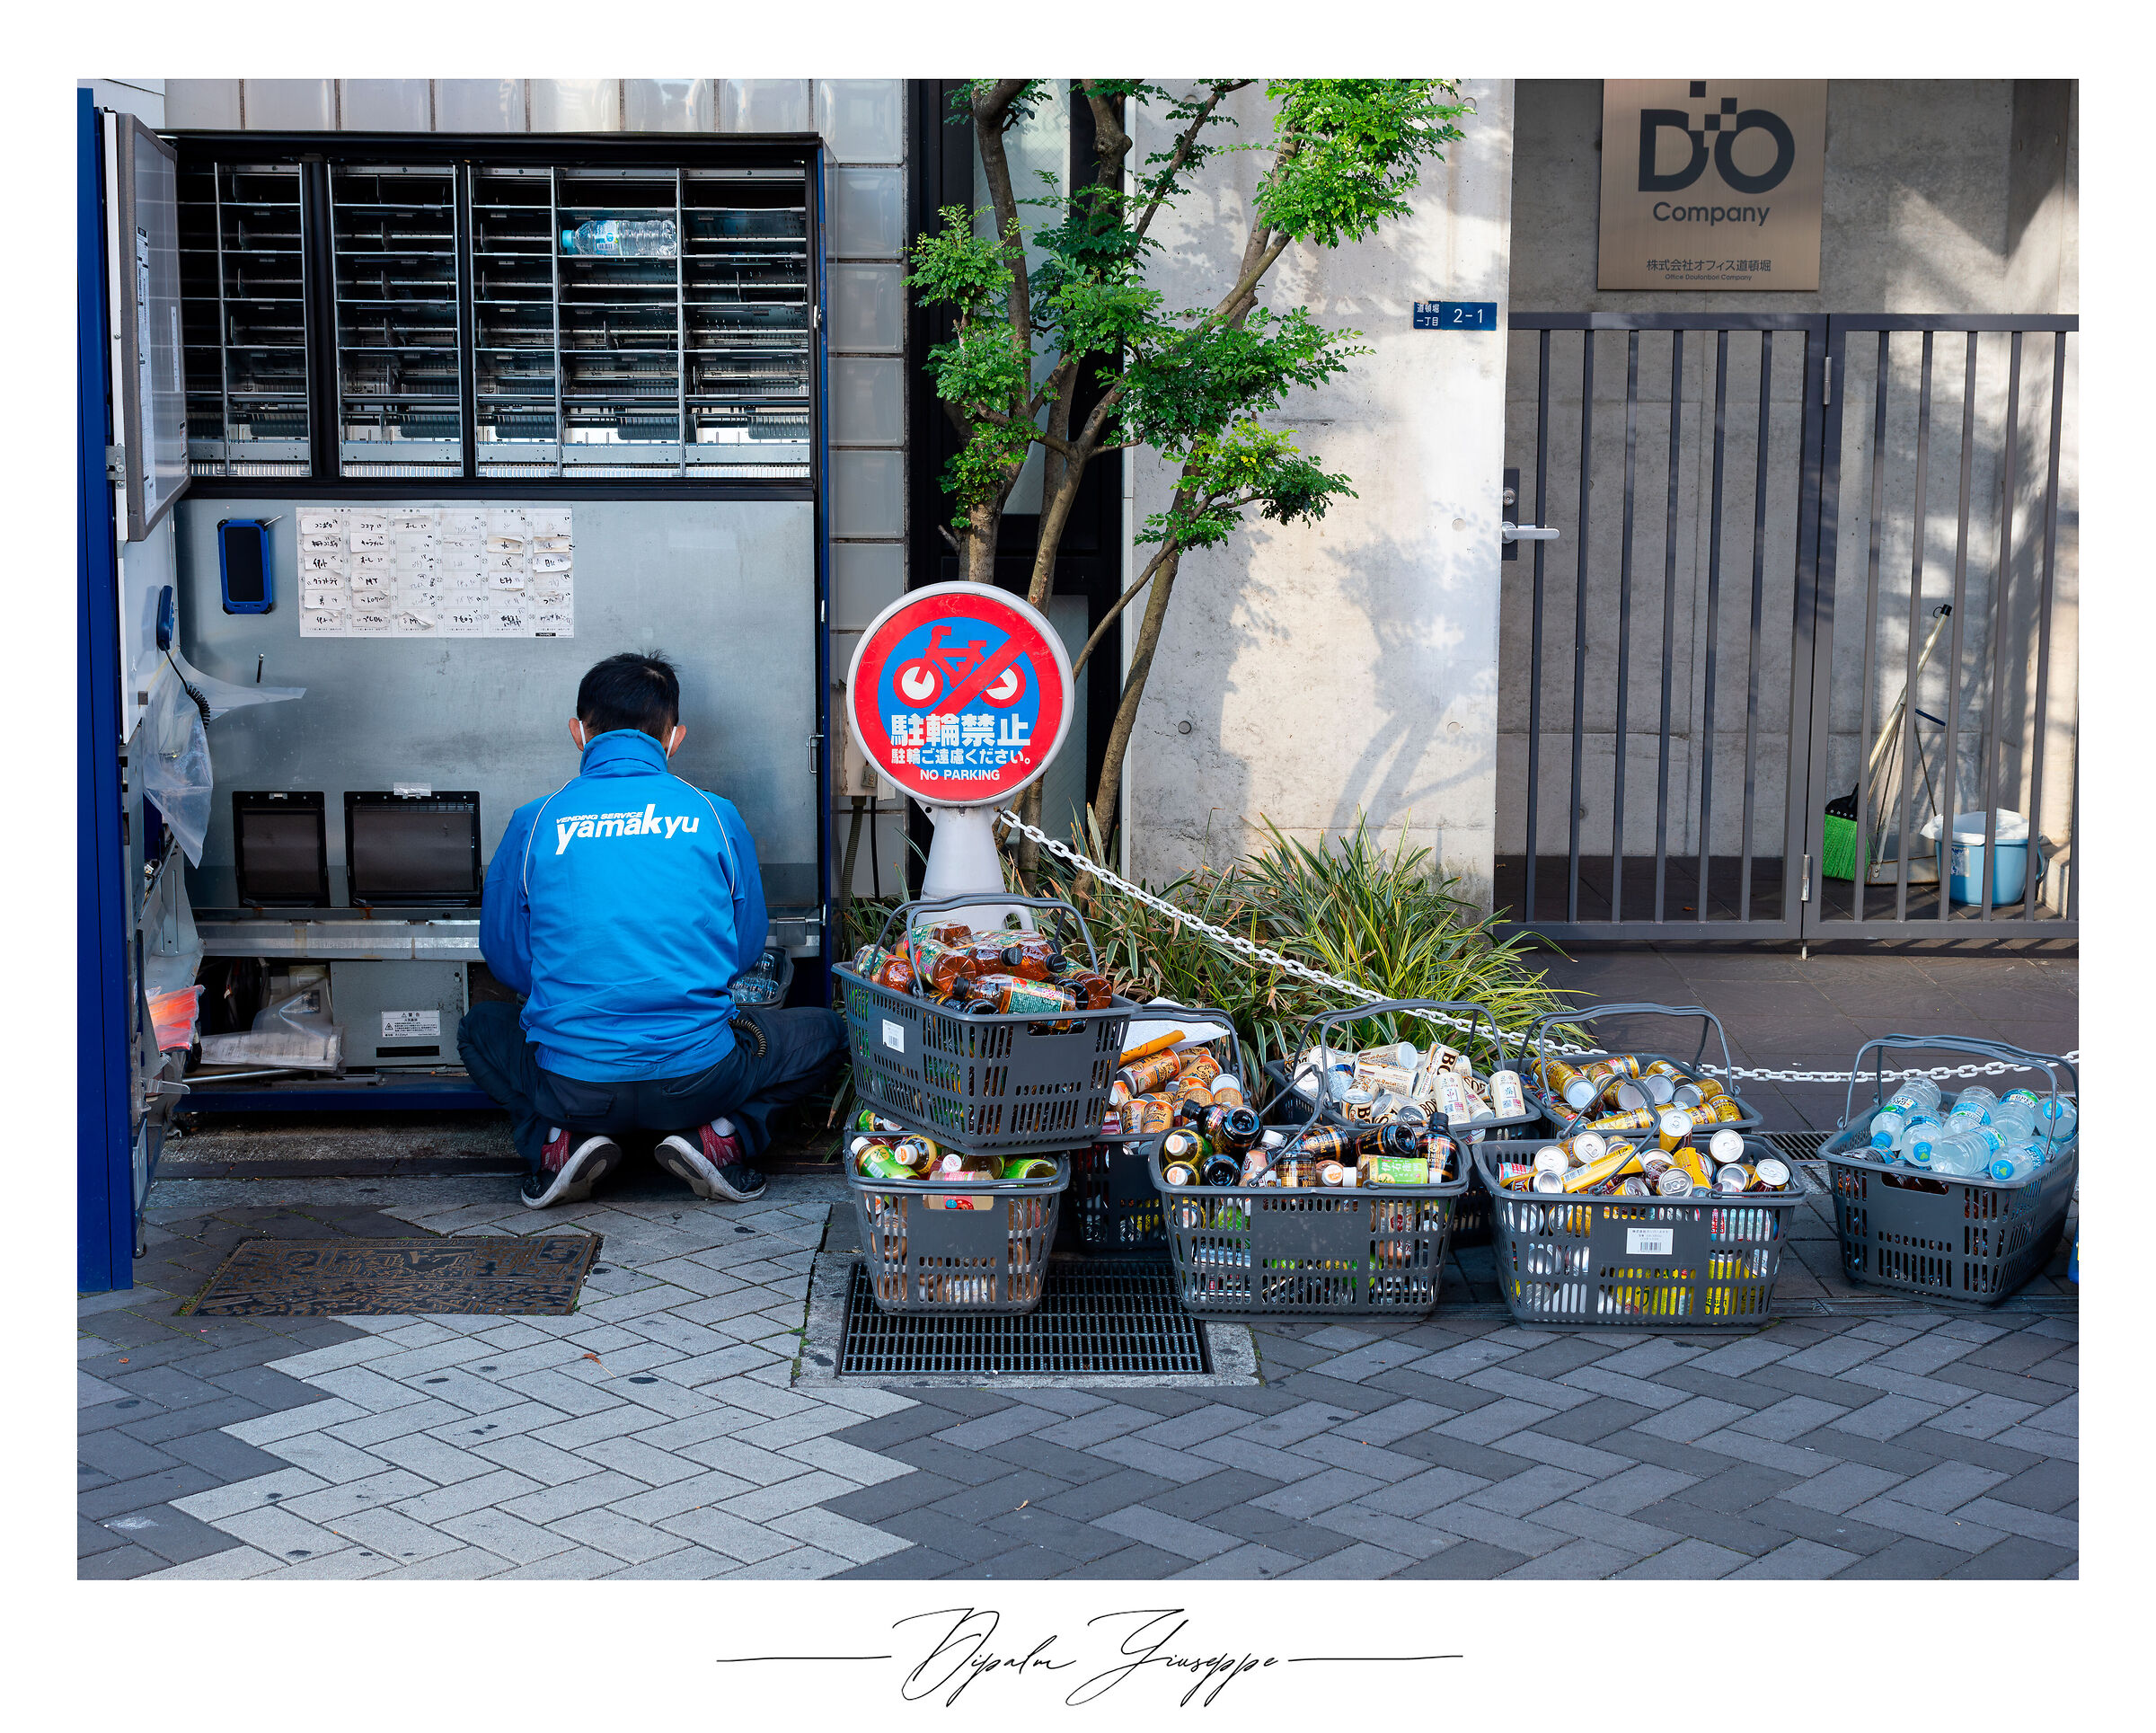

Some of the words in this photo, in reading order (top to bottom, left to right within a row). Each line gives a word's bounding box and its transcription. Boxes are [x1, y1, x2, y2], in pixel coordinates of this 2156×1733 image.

[1653, 201, 1771, 226] Company
[1646, 259, 1772, 272] 株式会社オフィス道頓堀
[1417, 303, 1440, 314] 道頓堀
[1453, 308, 1483, 323] 2-1
[1416, 316, 1439, 326] 一丁目
[890, 712, 1031, 747] 駐輪禁止
[890, 748, 1031, 765] 駐輪ご遠慮ください。
[920, 769, 940, 781] NO
[943, 769, 1001, 781] PARKING
[556, 814, 598, 824] VENDING
[600, 811, 644, 820] SERVICE
[555, 804, 700, 855] yamakyu
